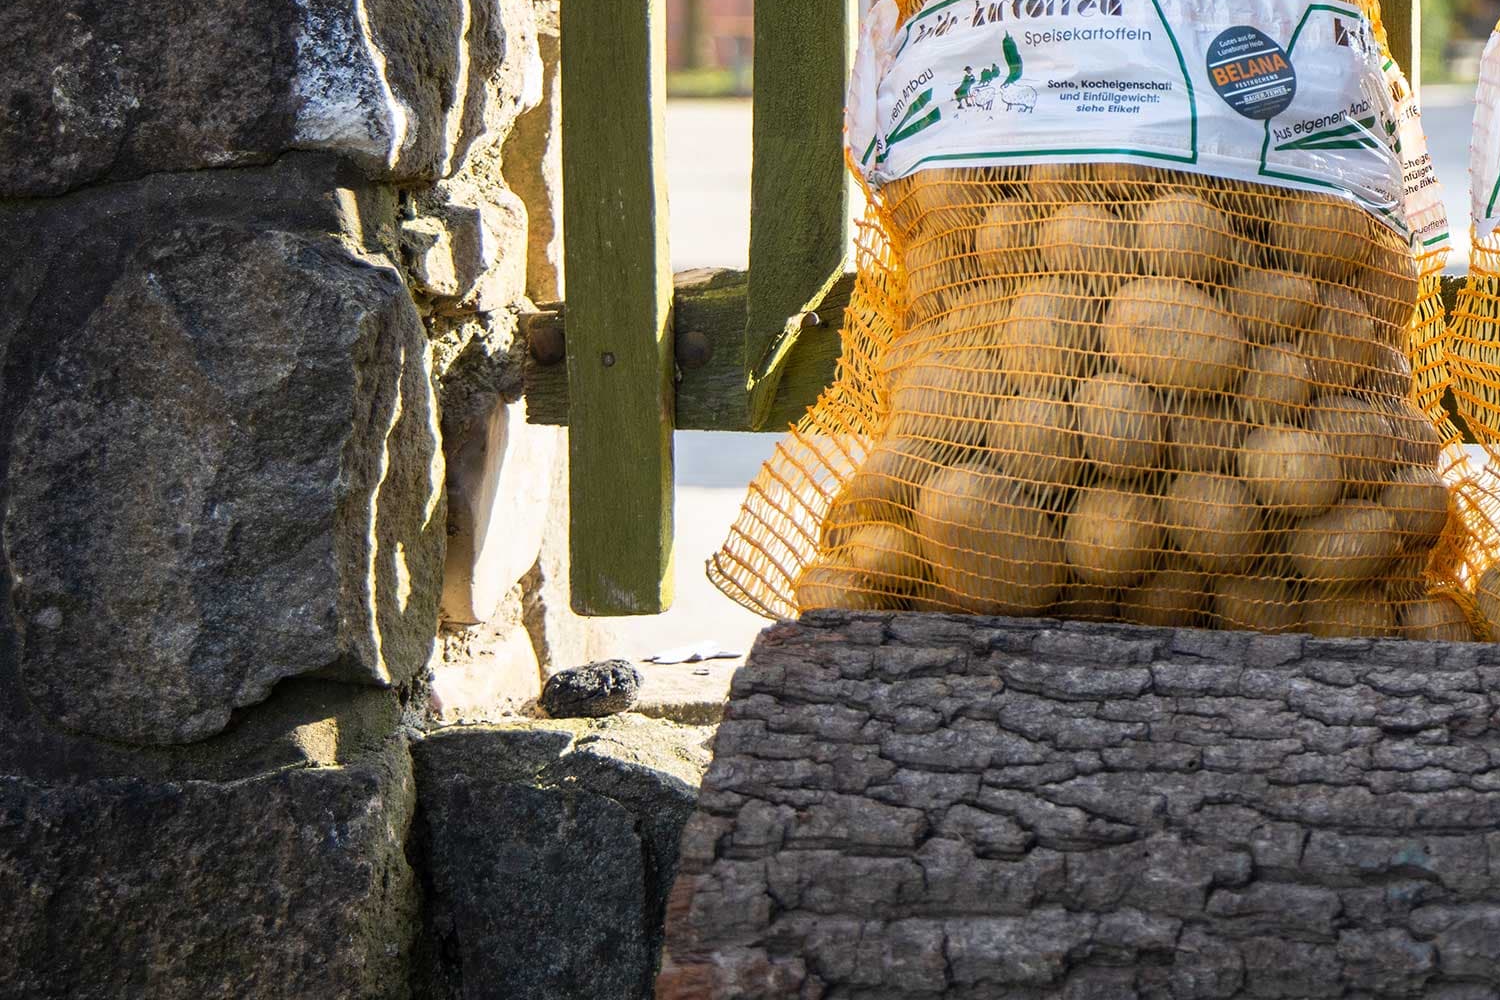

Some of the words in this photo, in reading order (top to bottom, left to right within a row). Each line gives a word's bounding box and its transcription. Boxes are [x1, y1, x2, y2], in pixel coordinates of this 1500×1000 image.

[1024, 26, 1152, 47] Speisekartoffeln
[1211, 53, 1288, 87] BELANA
[1047, 79, 1079, 90] Sorte,
[1059, 91, 1081, 101] und
[1083, 91, 1160, 104] Einfüllgewicht:
[1075, 104, 1105, 113] siehe
[1107, 104, 1140, 114] Etikett
[1293, 109, 1347, 134] eigenem
